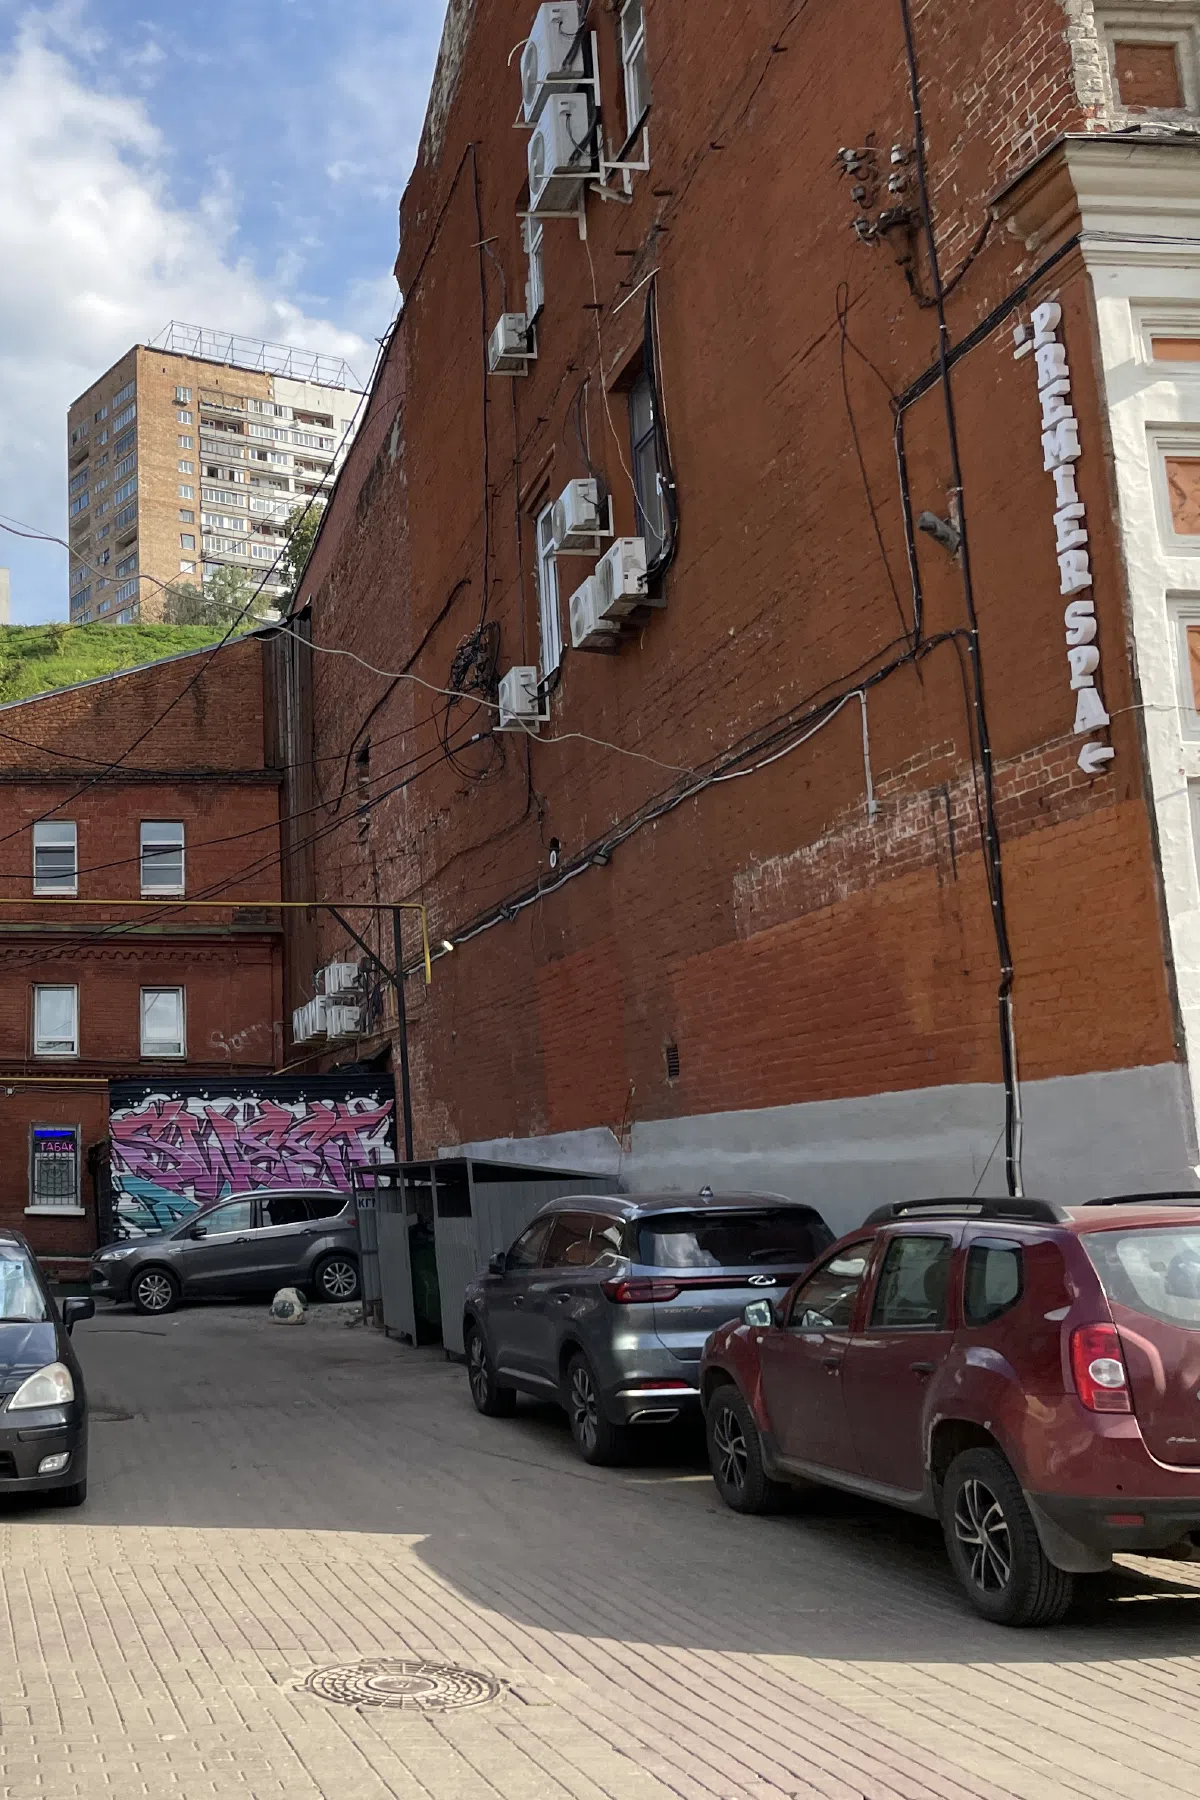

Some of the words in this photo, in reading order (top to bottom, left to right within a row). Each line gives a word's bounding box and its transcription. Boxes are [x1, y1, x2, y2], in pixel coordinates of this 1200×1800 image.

[1033, 302, 1093, 596] PREMIER
[1064, 600, 1111, 735] SPA
[40, 1142, 75, 1152] ТАБАК
